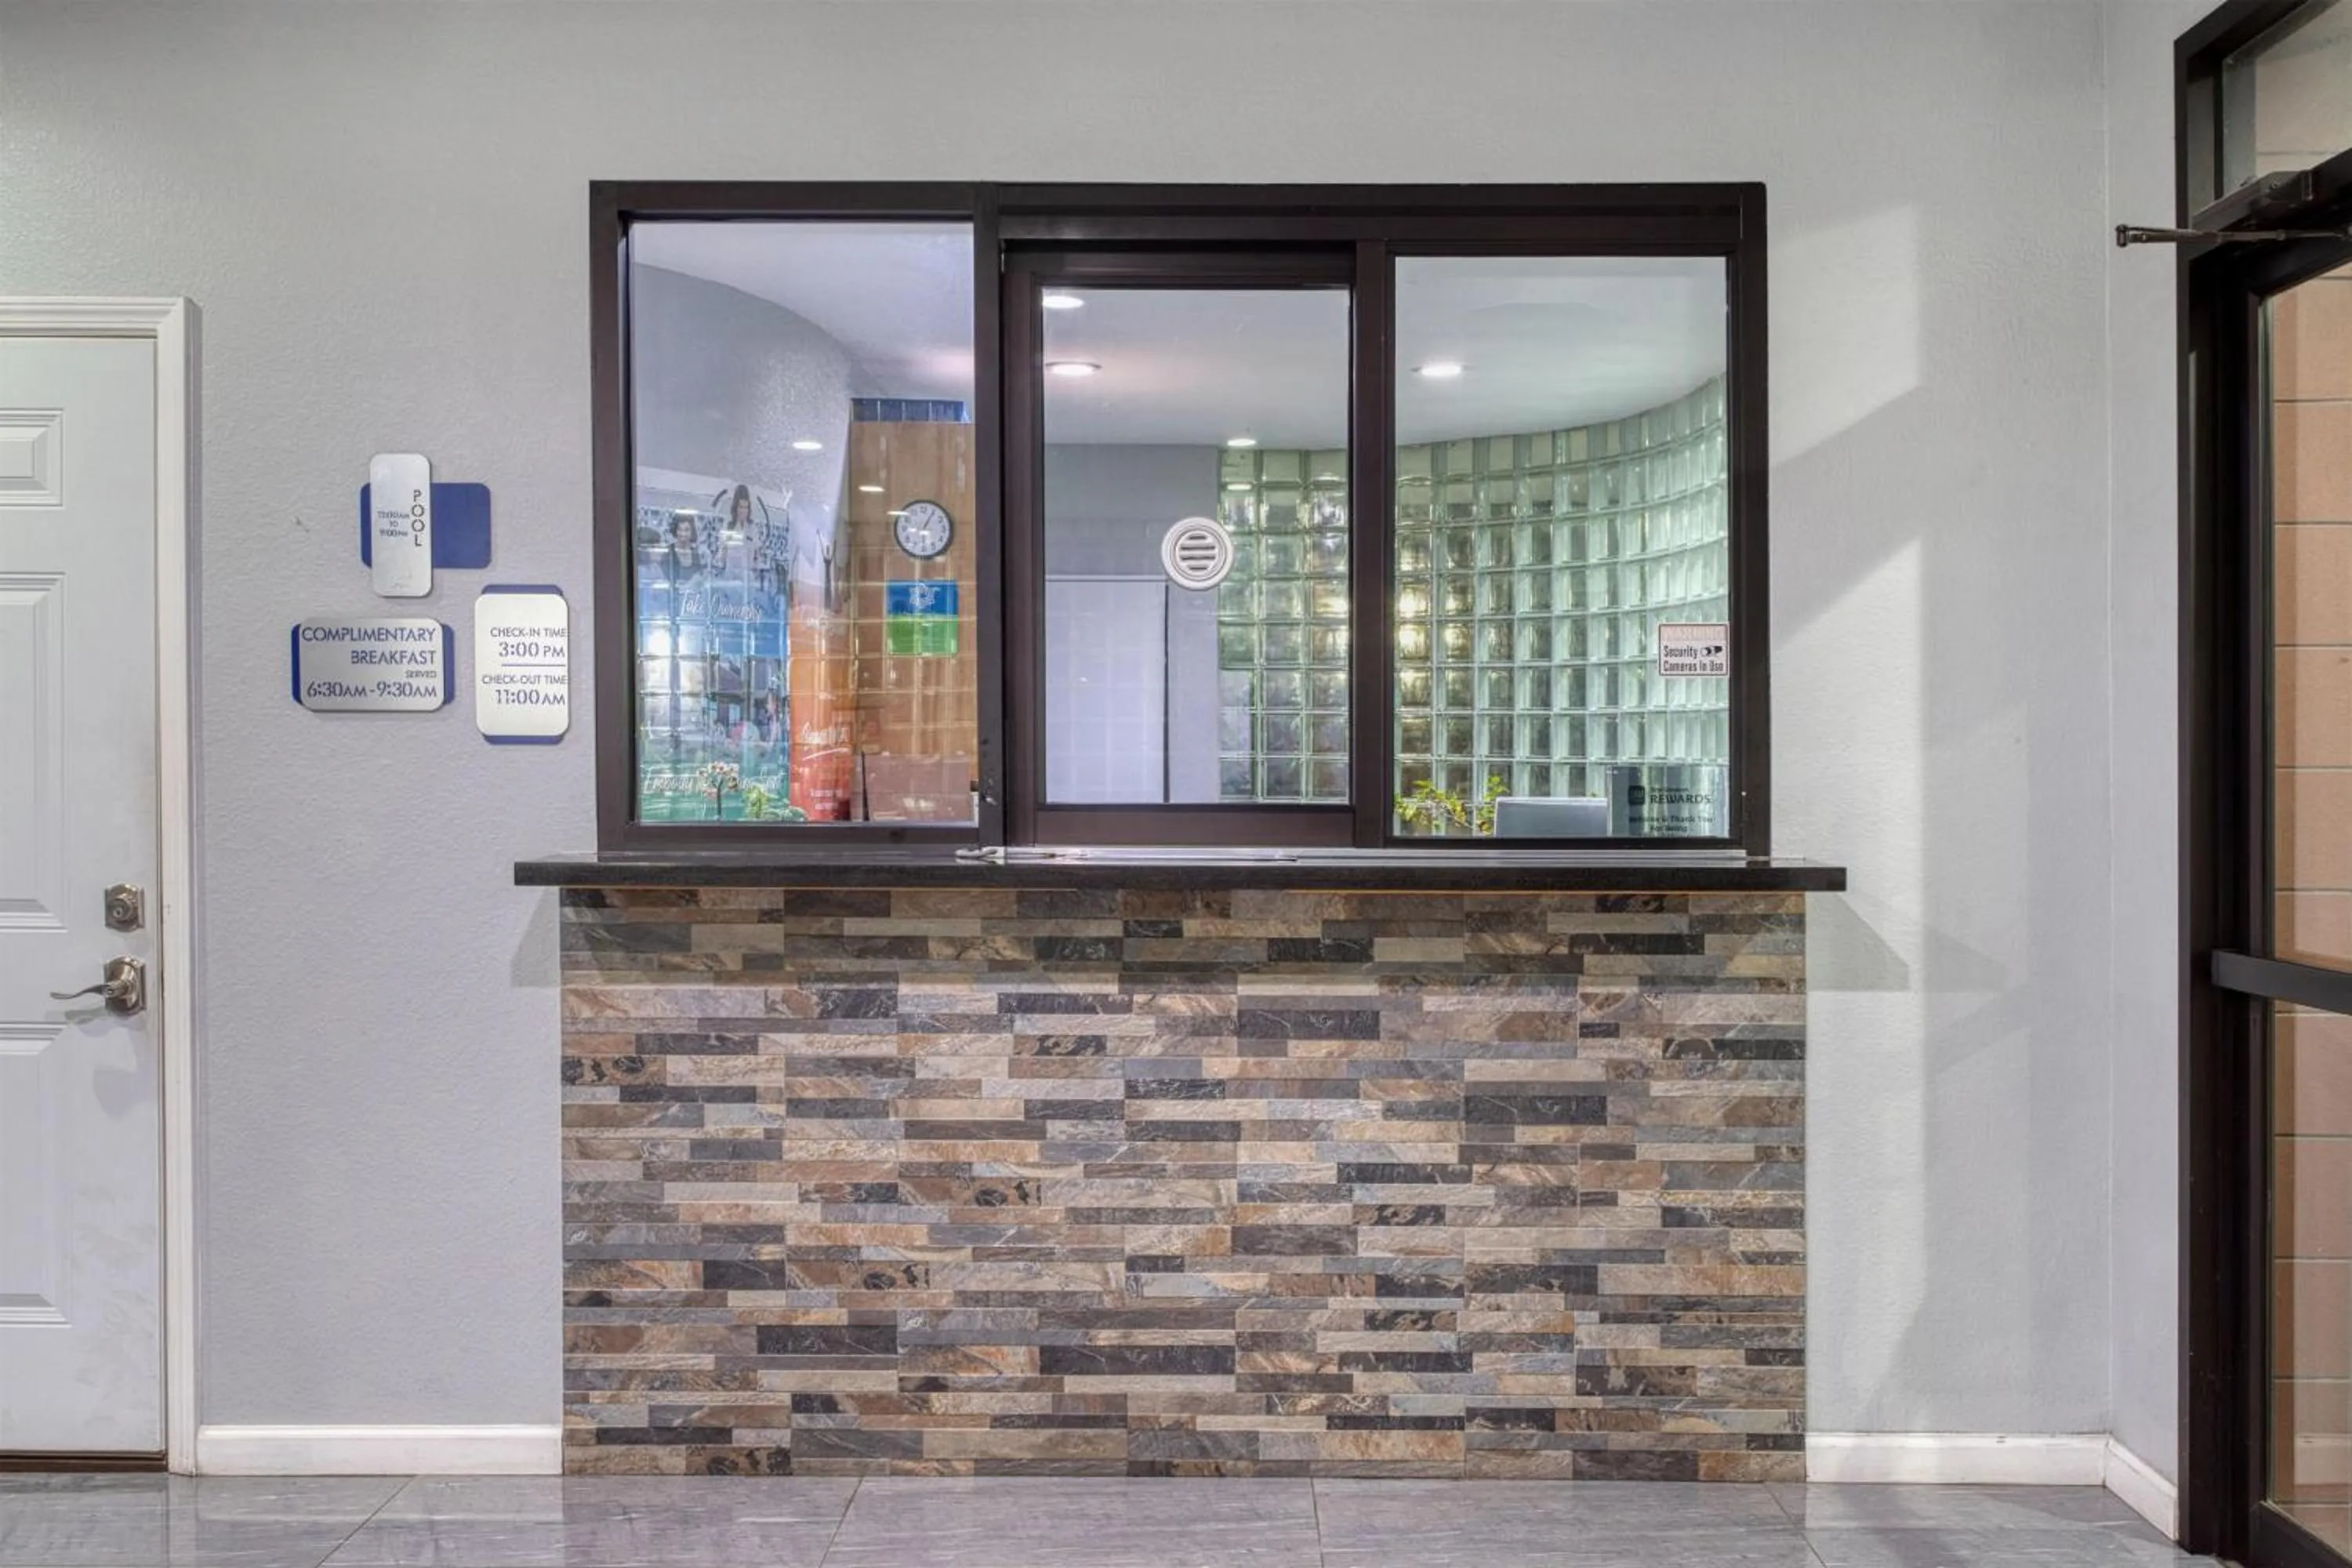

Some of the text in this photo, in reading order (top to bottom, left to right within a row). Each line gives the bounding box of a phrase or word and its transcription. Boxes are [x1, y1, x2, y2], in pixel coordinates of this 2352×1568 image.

[412, 488, 425, 546] POOL
[302, 626, 437, 642] COMPLIMENTARY
[490, 626, 570, 637] CHECK-IN TIME
[499, 641, 565, 658] 3:00 PM
[1664, 645, 1698, 659] Security
[350, 650, 437, 665] BREAKFAST
[1664, 660, 1697, 671] Cameras
[481, 675, 569, 684] CHECK-OUT TIME
[495, 689, 566, 706] 11:00AM
[1650, 794, 1712, 804] REWARDS
